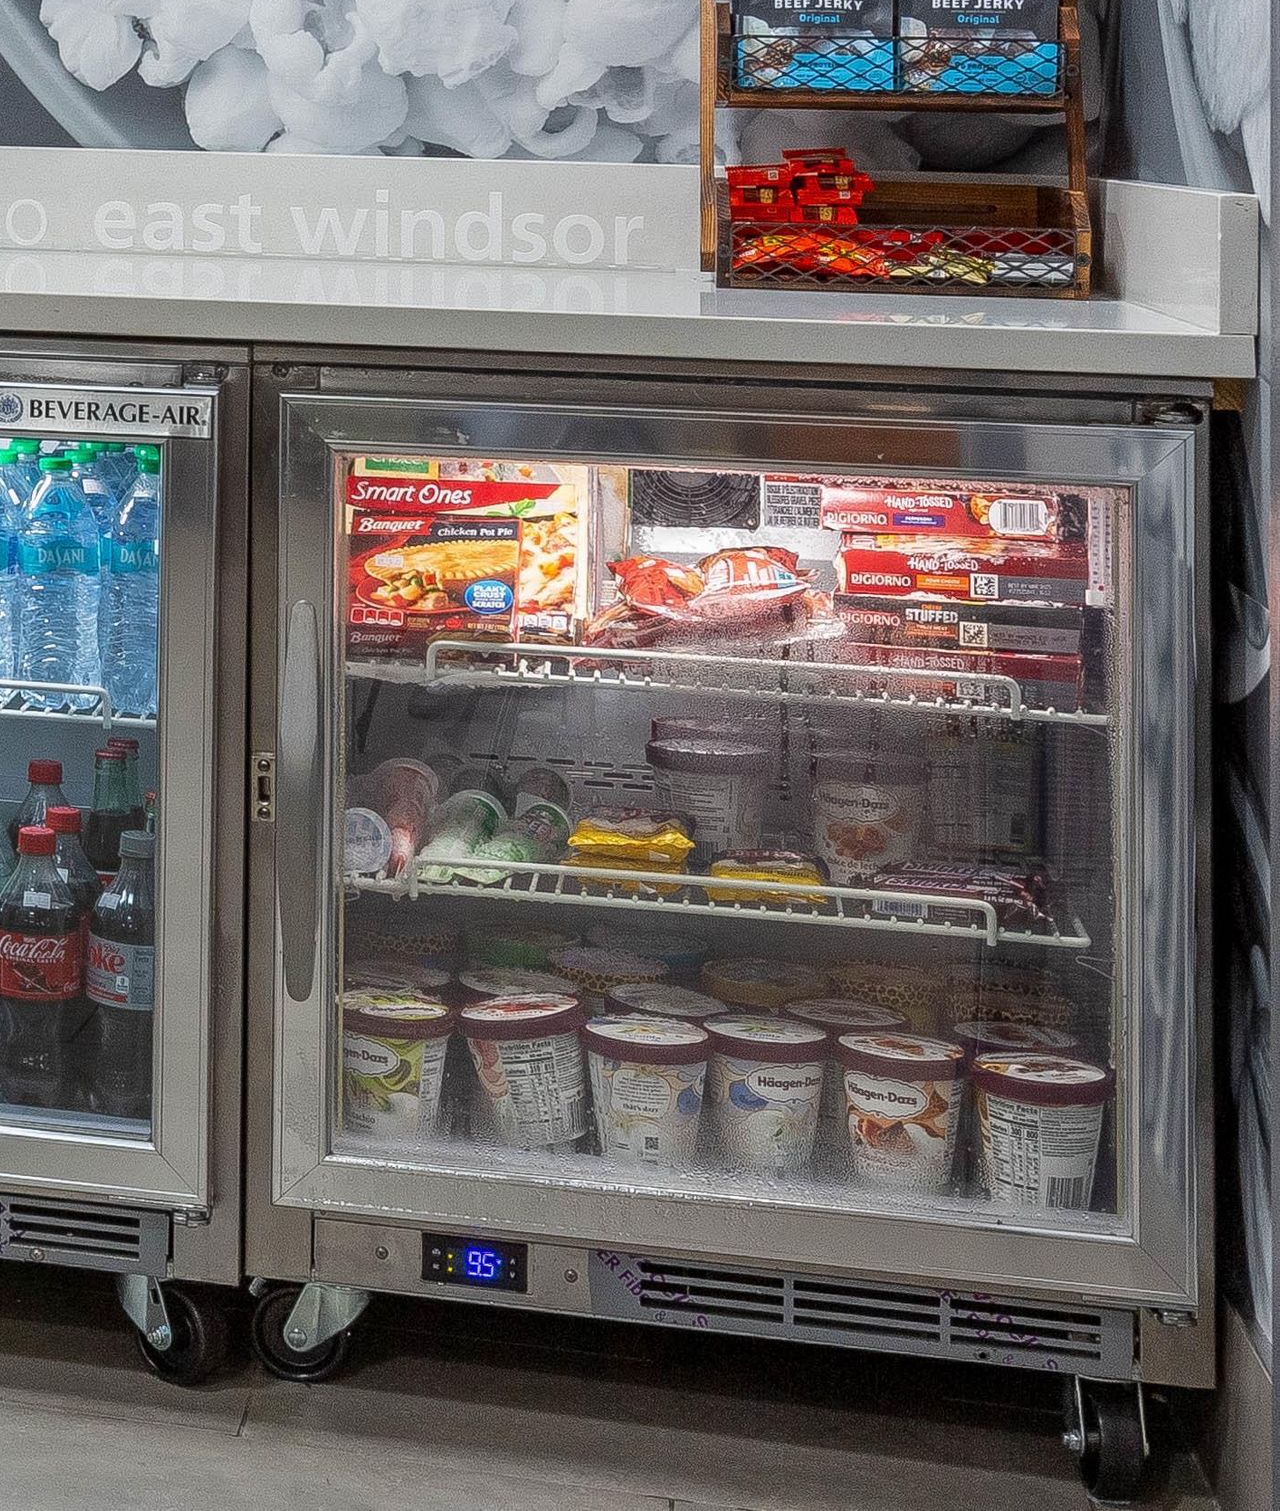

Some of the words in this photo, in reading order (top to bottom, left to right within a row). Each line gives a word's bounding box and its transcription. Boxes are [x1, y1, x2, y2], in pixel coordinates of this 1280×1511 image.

[814, 0, 863, 11] JERKY
[799, 13, 841, 24] Original
[957, 14, 1000, 25] Original
[93, 193, 263, 254] east
[289, 188, 645, 266] windsor
[29, 399, 201, 426] BEVERAGE-AIR
[351, 481, 414, 501] Smart
[418, 484, 472, 505] Ones
[884, 495, 953, 510] HAND-TOSSED
[358, 517, 424, 534] Banquet
[826, 512, 887, 526] DIGIORNO
[438, 528, 477, 537] Chicken
[480, 528, 495, 537] Pot
[497, 528, 513, 536] Pie
[38, 546, 85, 568] DASANI
[851, 573, 911, 586] DIGIORNO
[473, 584, 506, 593] FLAKY
[473, 592, 506, 600] CRUST
[472, 600, 505, 609] SCRATCH
[840, 611, 900, 627] DIGIORNO
[905, 608, 959, 624] STUFFED
[350, 631, 401, 645] Banquet
